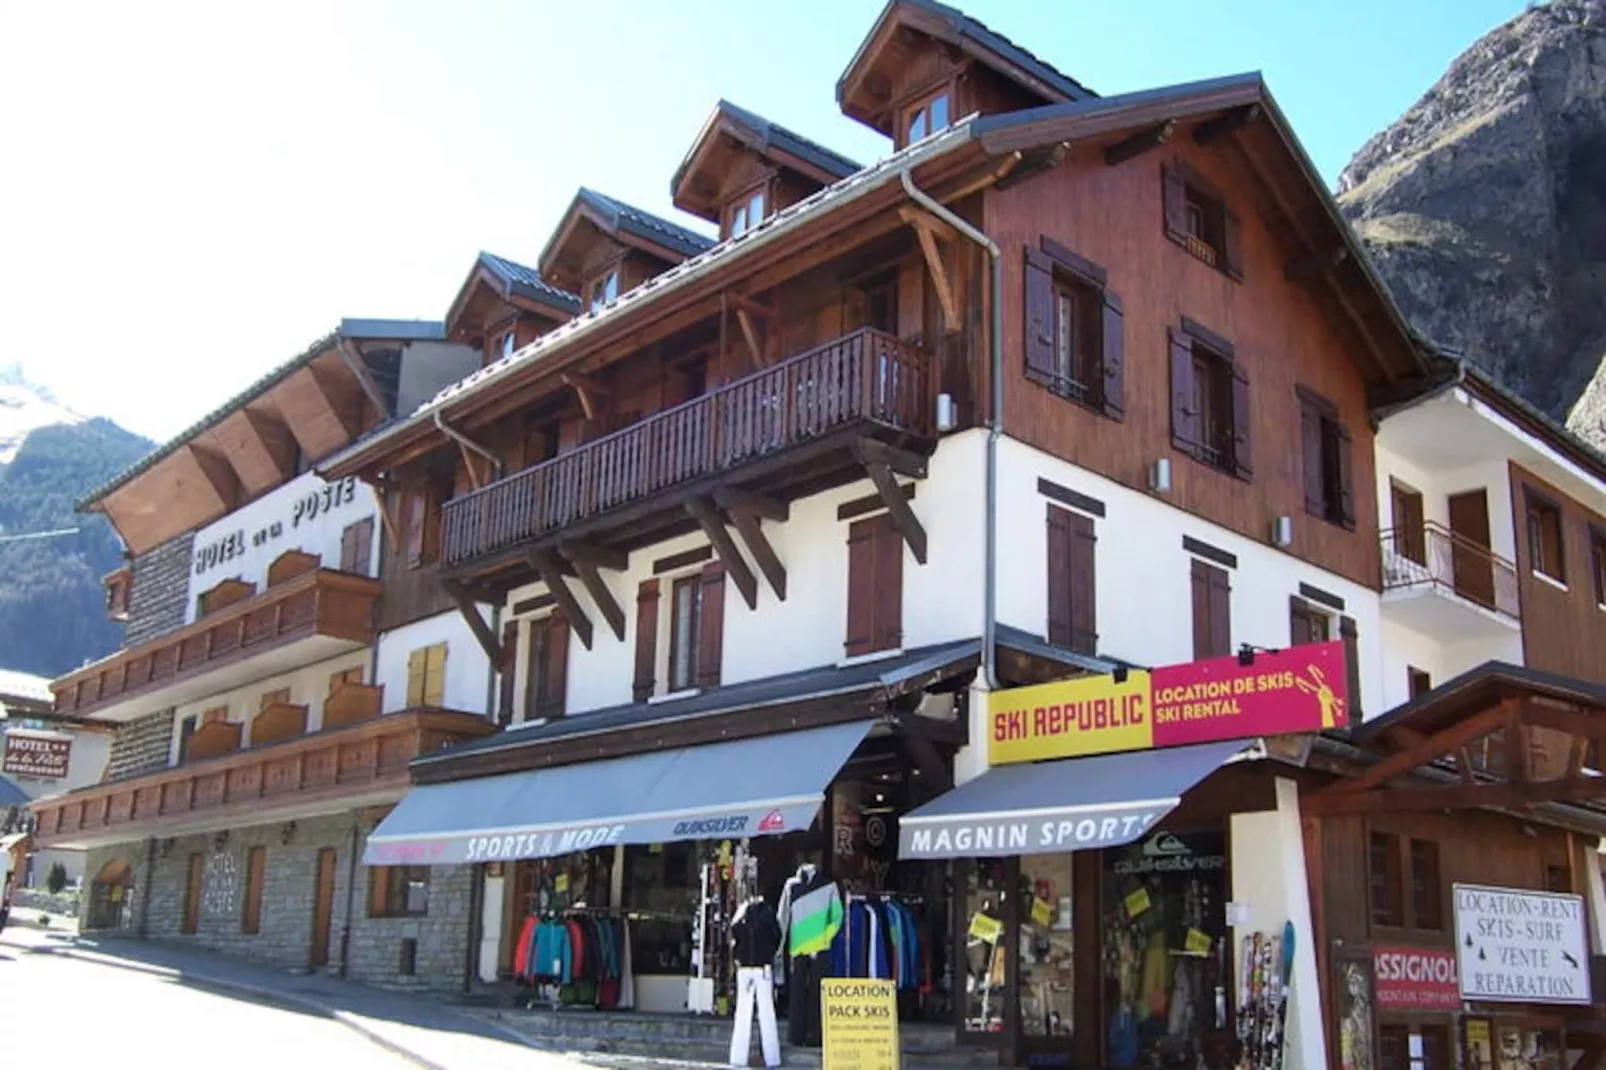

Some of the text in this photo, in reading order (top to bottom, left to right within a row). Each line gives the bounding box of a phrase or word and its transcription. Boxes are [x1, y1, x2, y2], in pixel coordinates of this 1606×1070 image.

[195, 529, 246, 574] HOTEL
[292, 477, 355, 529] POSTE
[1155, 671, 1294, 705] LOCATION DE SKIS
[1155, 698, 1241, 724] SKI RENTAL
[994, 710, 1028, 743] SKI
[9, 739, 50, 752] HOTEL
[464, 833, 538, 860] SPORTS
[557, 825, 626, 851] MODE
[910, 824, 1029, 853] MAGNIN
[1499, 947, 1549, 968] VENTE
[828, 984, 890, 998] LOCATION
[1474, 972, 1574, 995] REPARATION
[828, 1004, 890, 1018] PACK SKIS
